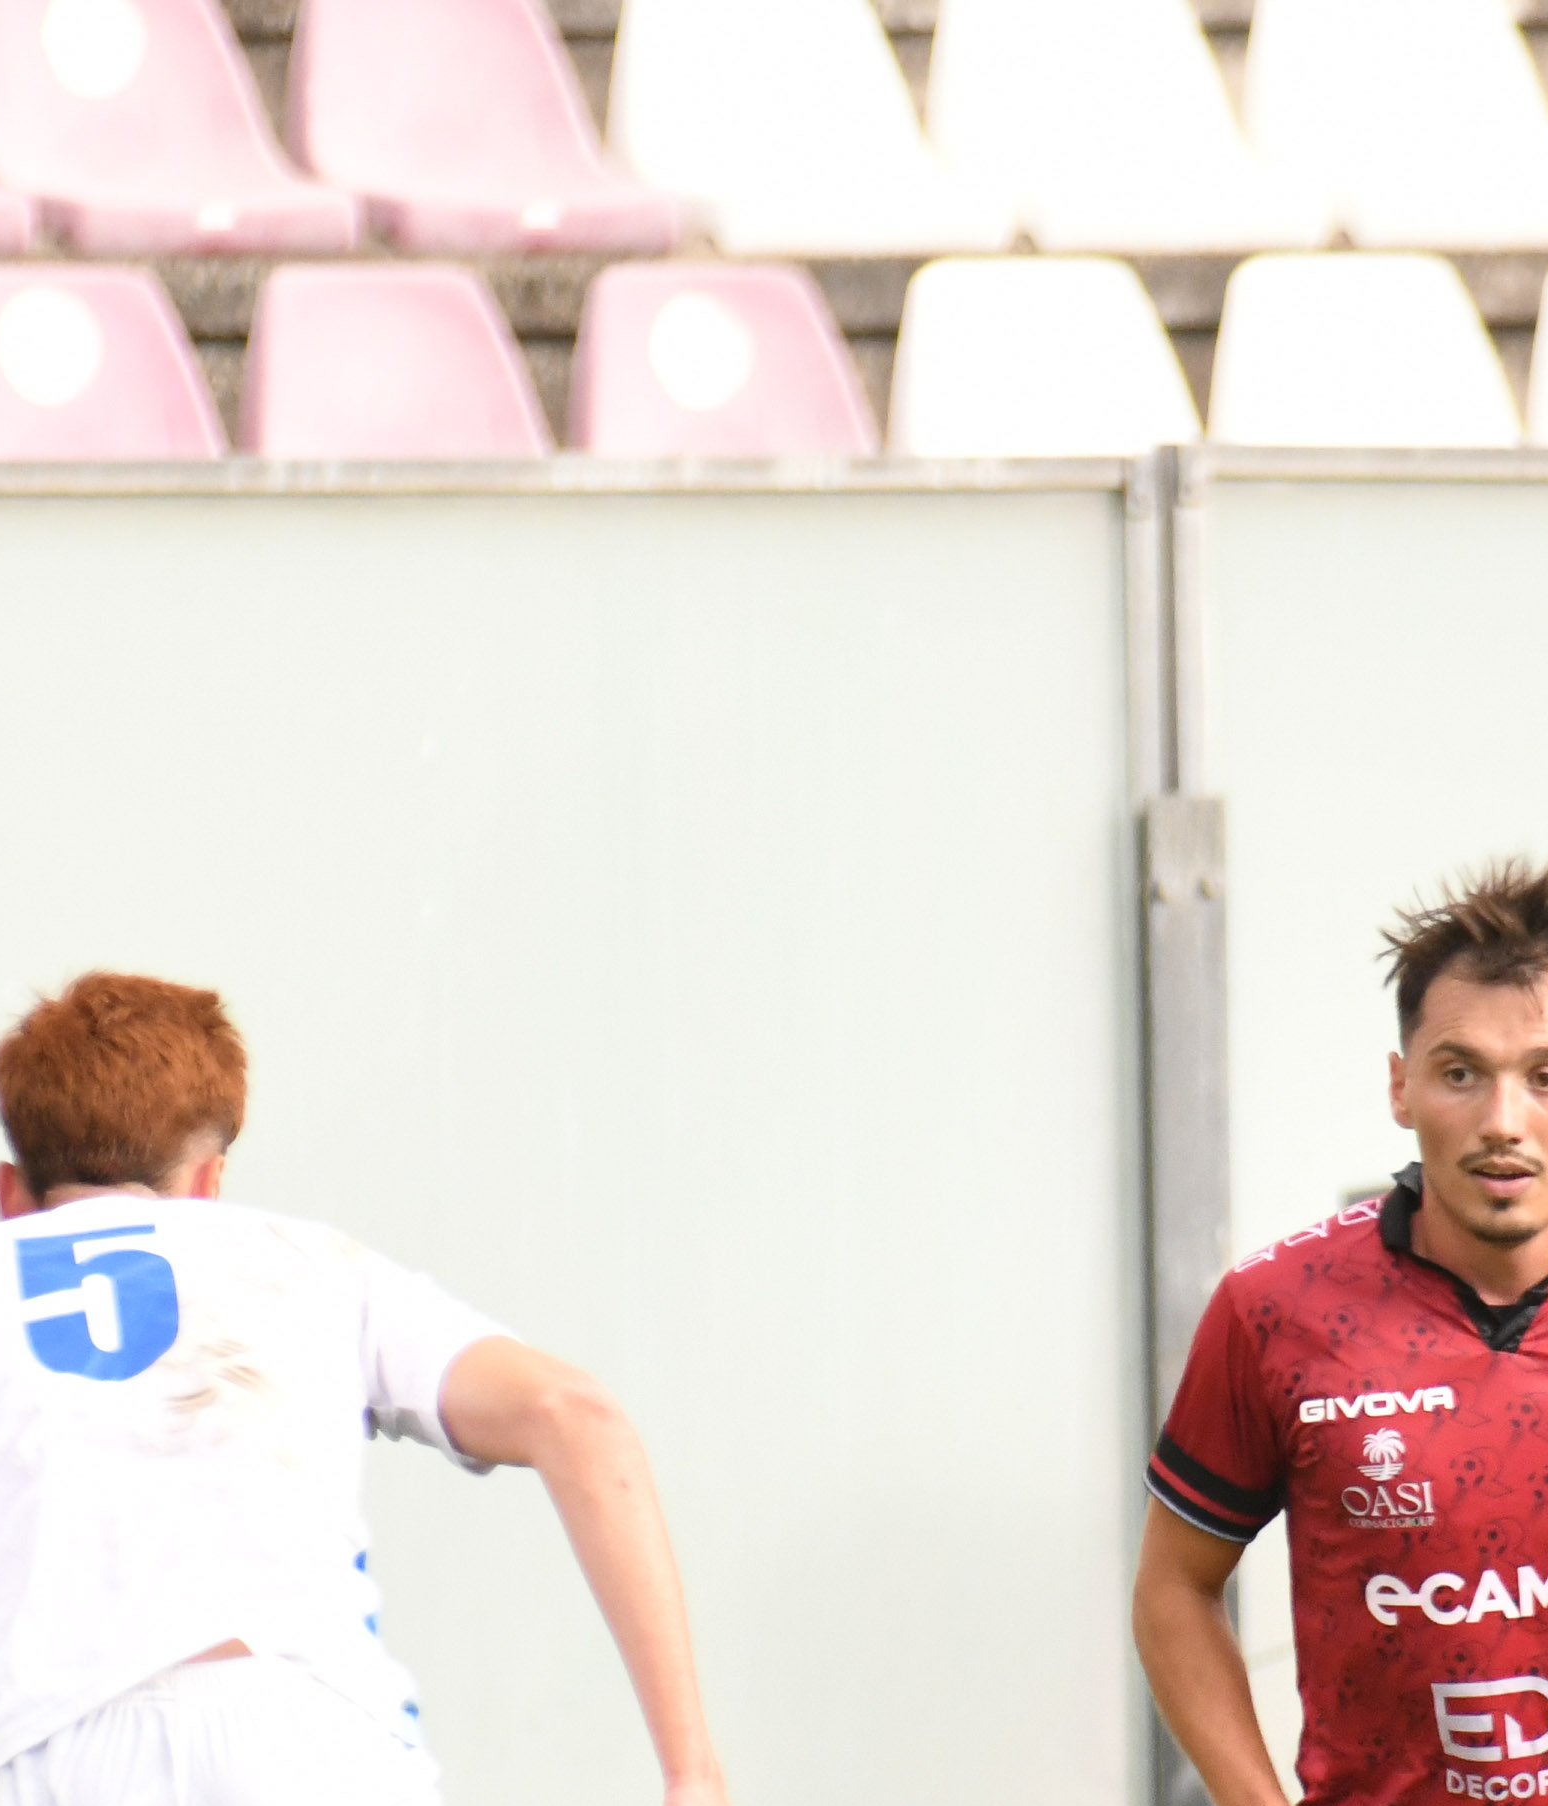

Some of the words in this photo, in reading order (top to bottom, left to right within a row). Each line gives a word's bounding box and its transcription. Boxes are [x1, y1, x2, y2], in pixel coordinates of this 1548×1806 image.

[14, 1224, 180, 1381] 5
[1299, 1386, 1456, 1423] GIVOVA
[1341, 1481, 1435, 1516] OASI
